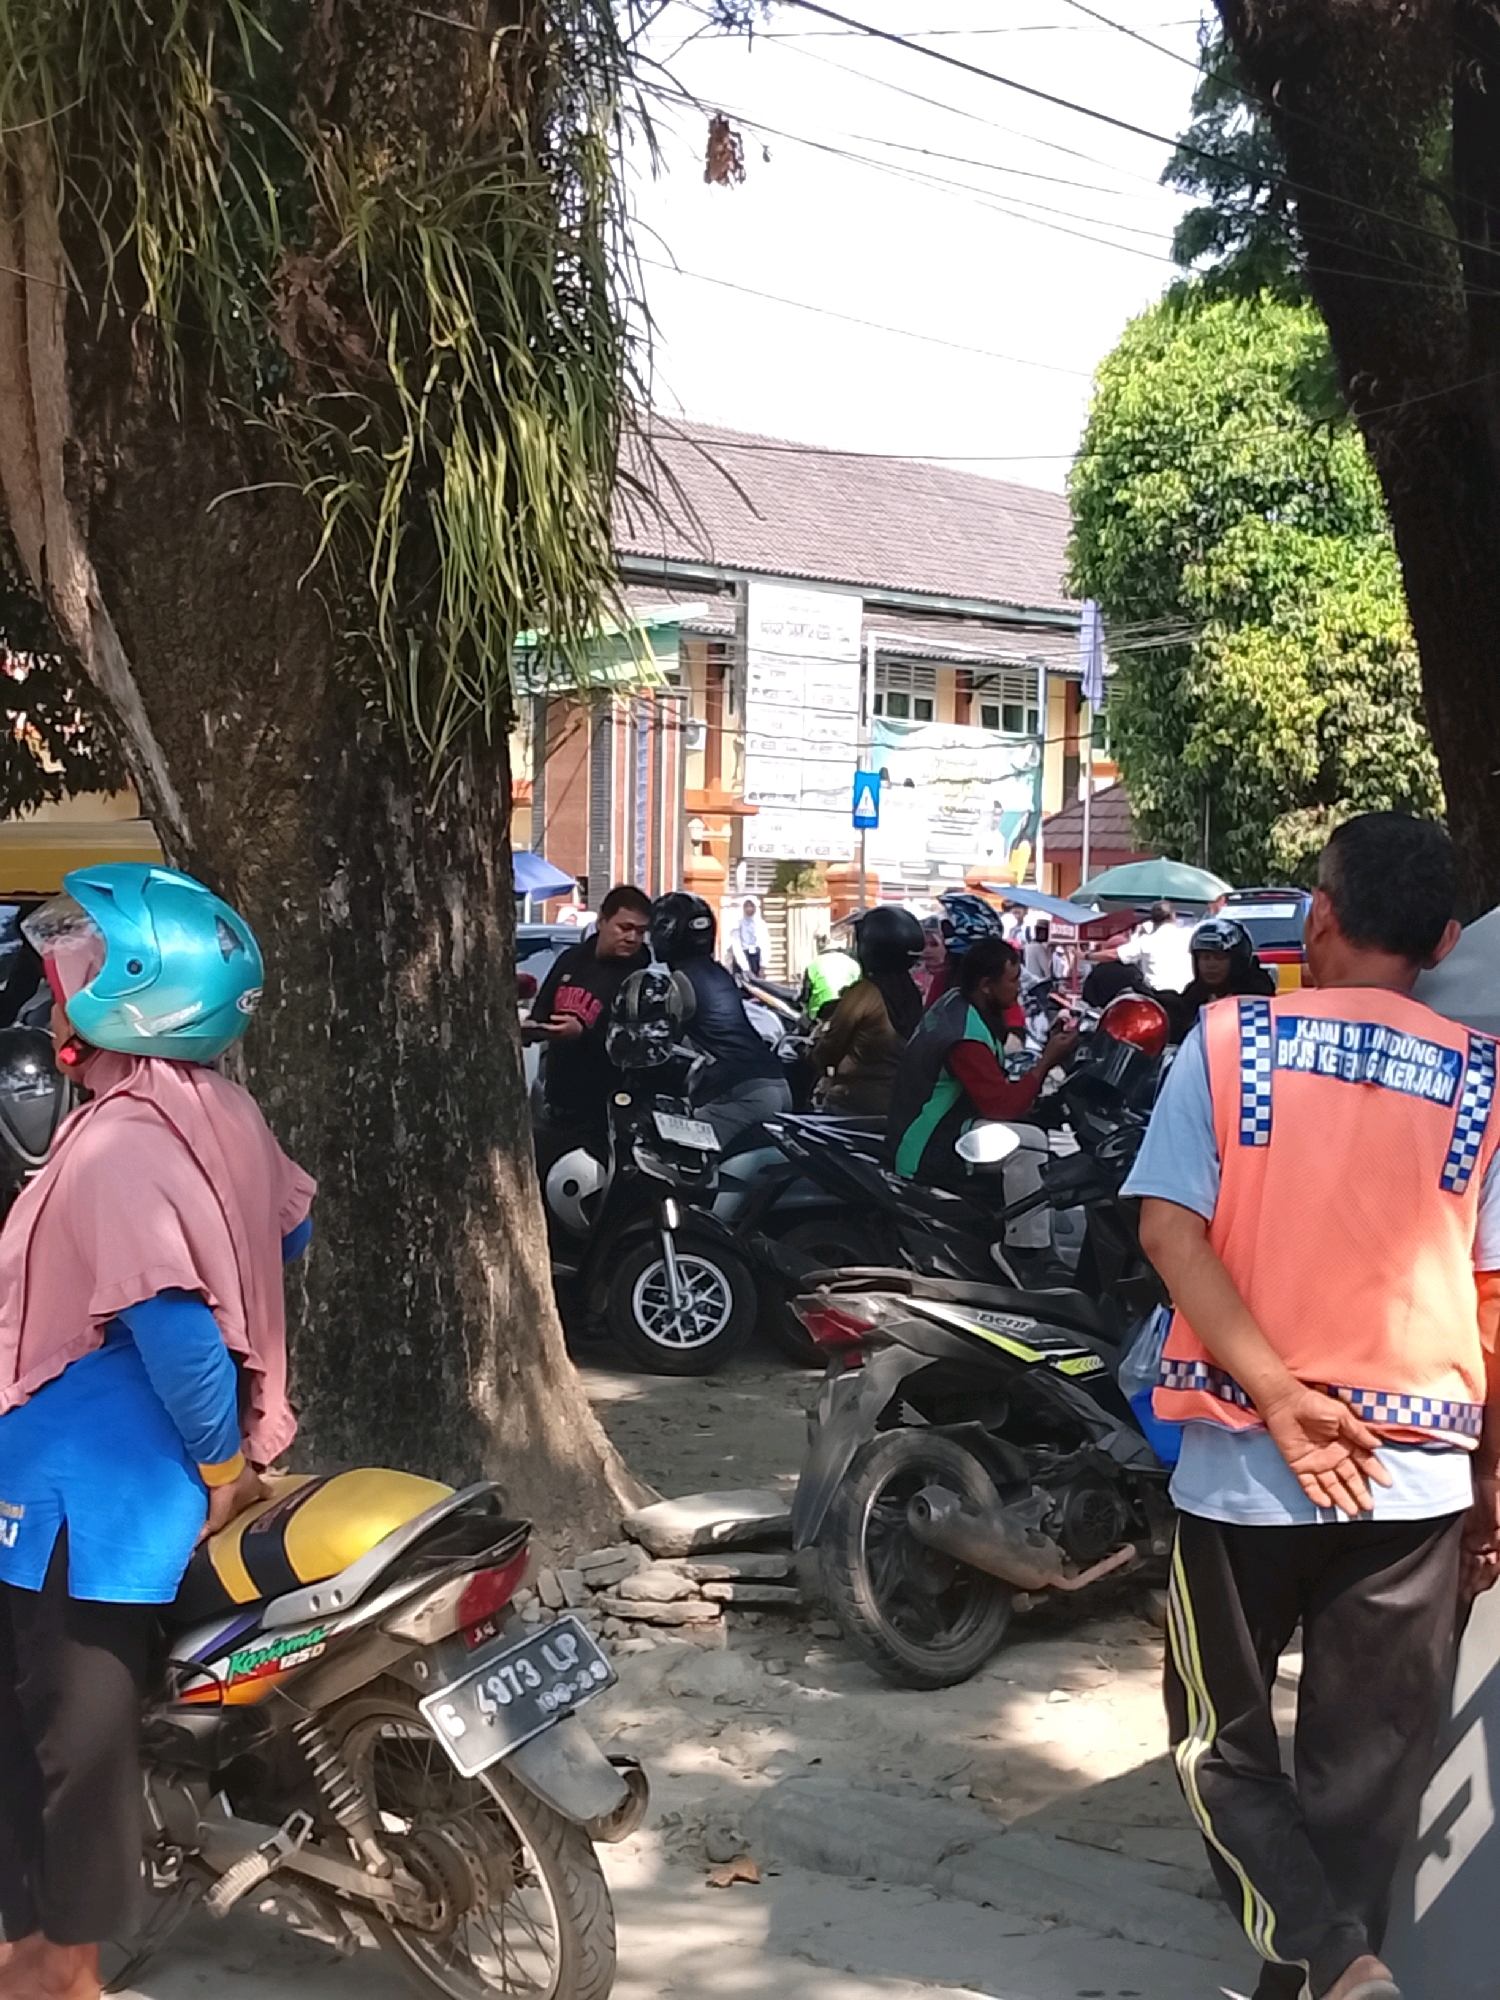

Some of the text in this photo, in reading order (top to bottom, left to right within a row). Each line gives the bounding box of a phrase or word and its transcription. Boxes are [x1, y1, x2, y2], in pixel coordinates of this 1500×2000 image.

[1278, 1039, 1315, 1068] BPJS
[1297, 1019, 1444, 1068] KAMI DI LINDUNGI
[541, 1632, 580, 1671] LP
